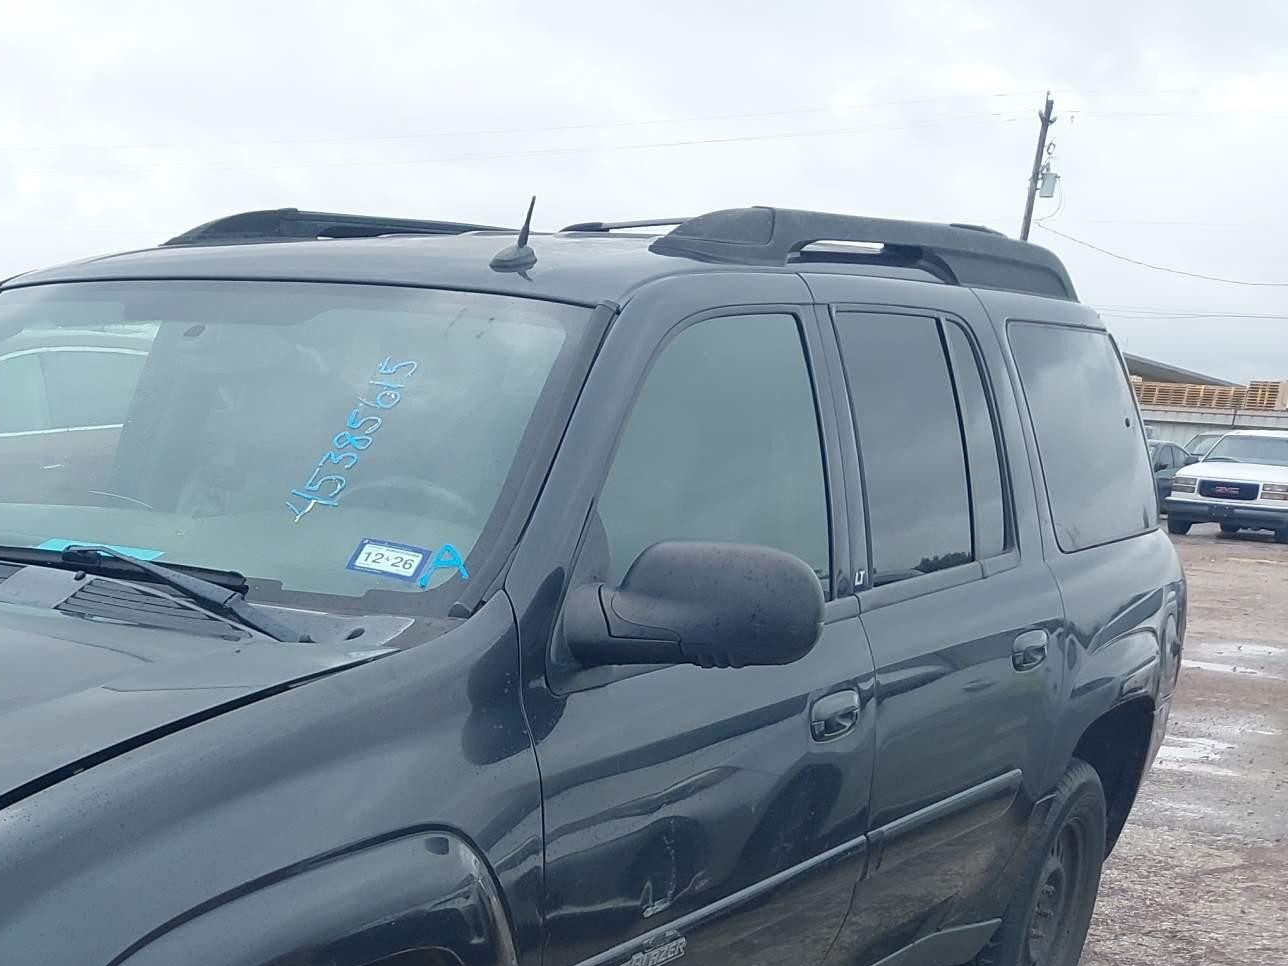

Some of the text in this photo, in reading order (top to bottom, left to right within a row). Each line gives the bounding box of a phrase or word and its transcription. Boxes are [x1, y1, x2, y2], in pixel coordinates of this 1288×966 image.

[286, 356, 418, 523] 45385615
[418, 543, 470, 589] A
[854, 570, 865, 586] LT
